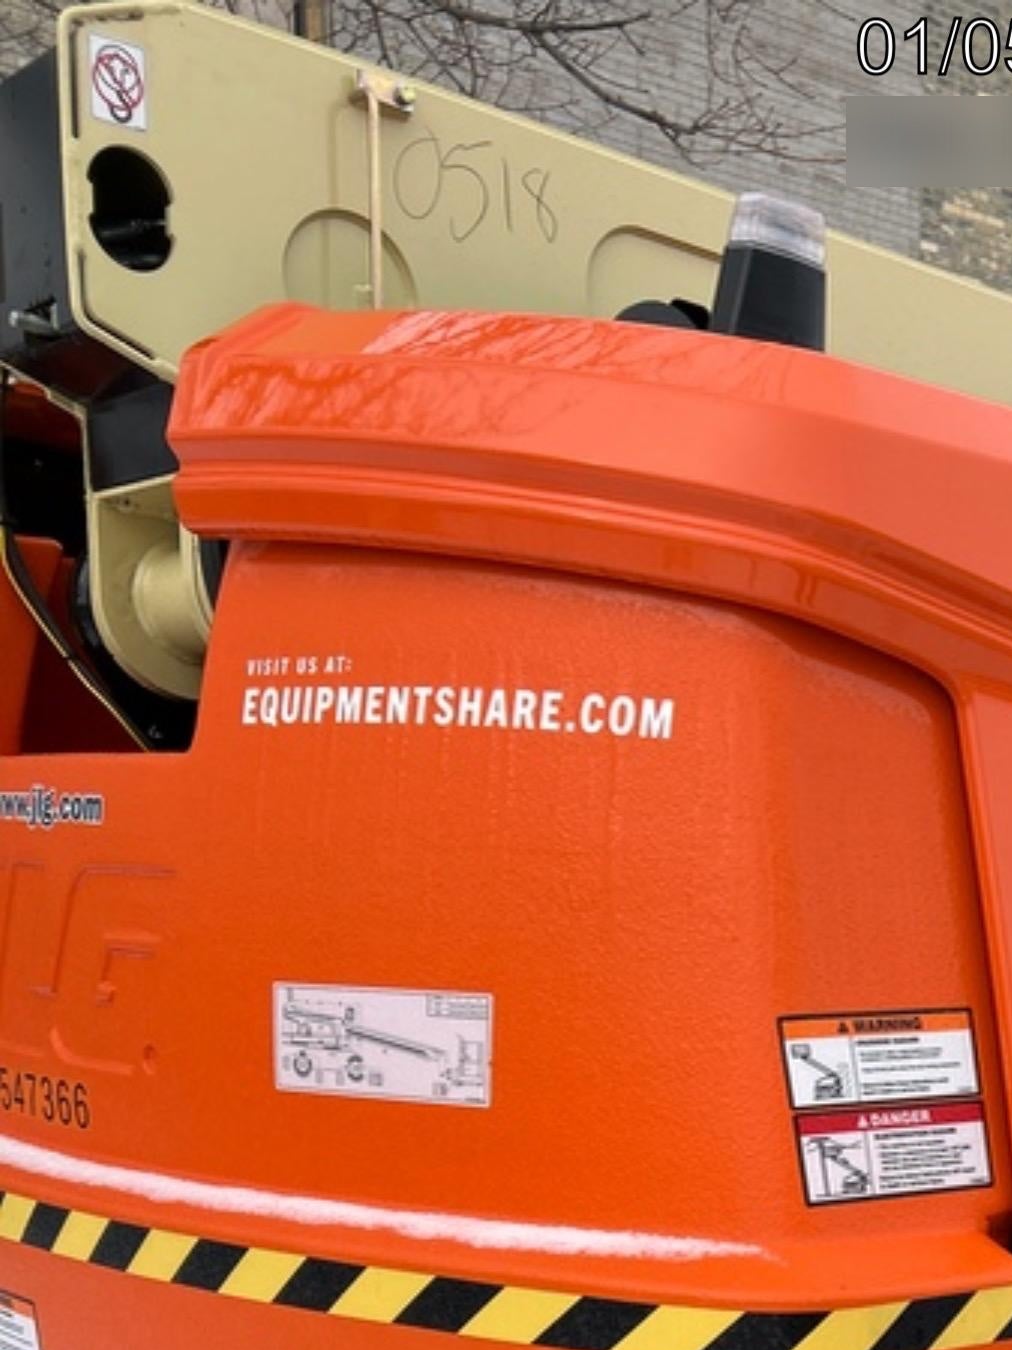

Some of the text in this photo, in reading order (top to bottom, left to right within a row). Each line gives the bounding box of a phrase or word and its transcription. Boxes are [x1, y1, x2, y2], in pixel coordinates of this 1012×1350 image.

[393, 126, 558, 244] 0518
[246, 656, 352, 676] VISIT US AT:
[241, 685, 675, 739] EQUIPMENTSHARE.COM
[852, 1017, 922, 1033] WARNING
[0, 1067, 90, 1129] 547366
[871, 1110, 931, 1127] DANGER
